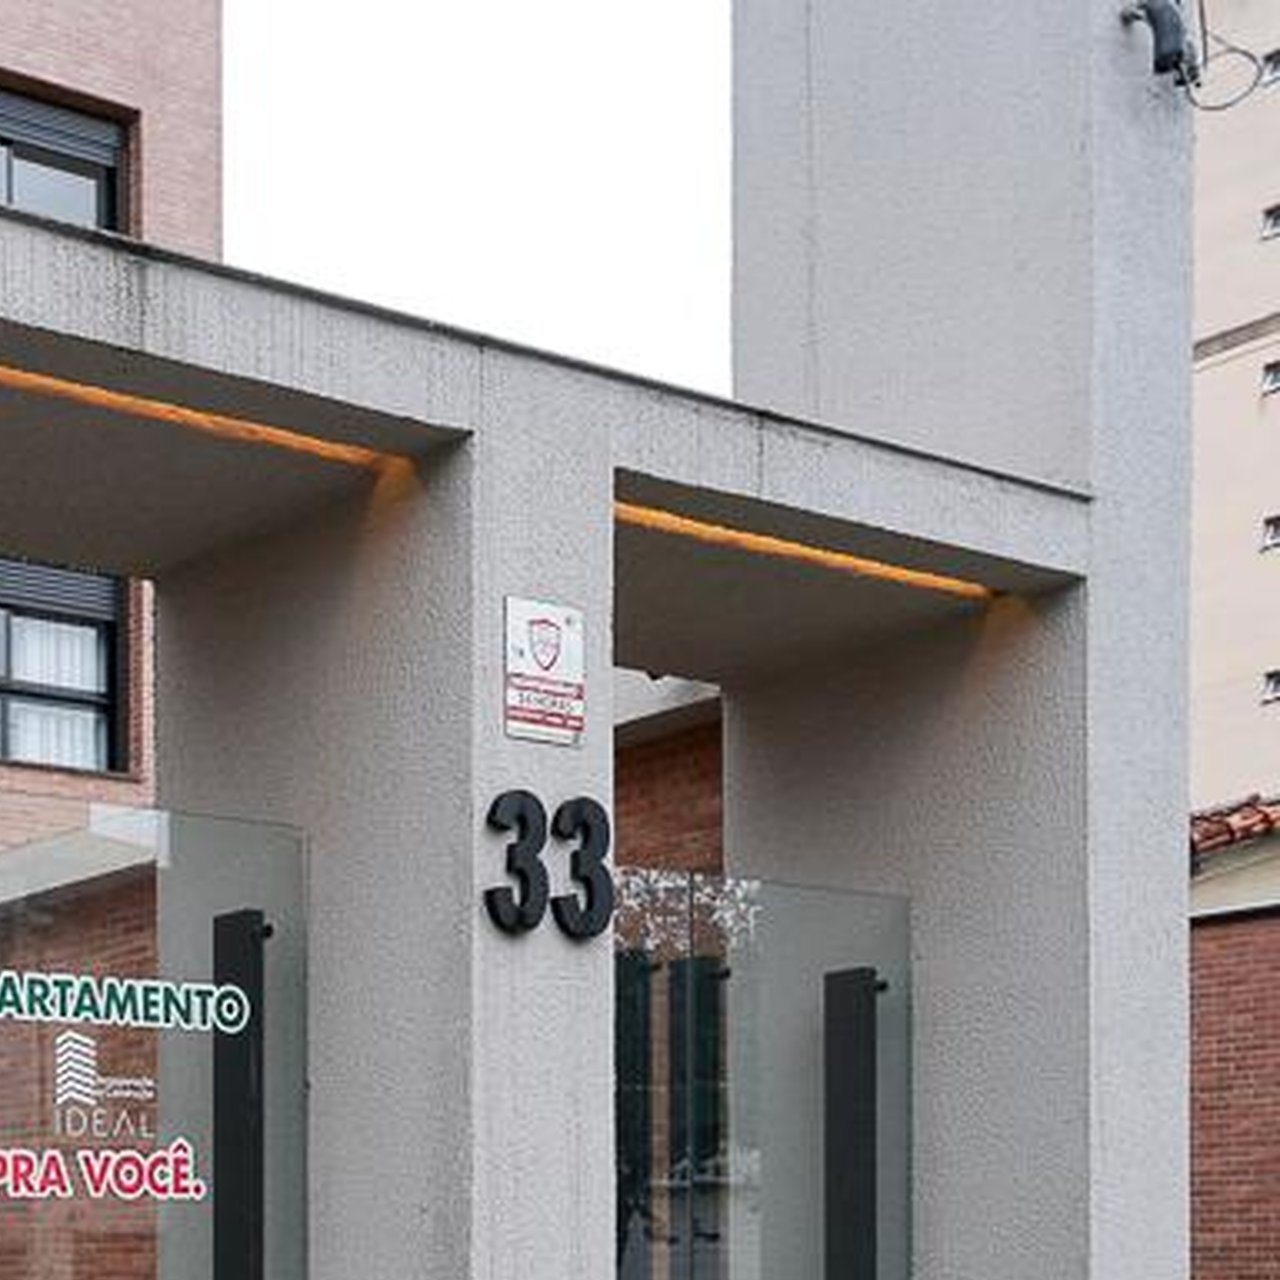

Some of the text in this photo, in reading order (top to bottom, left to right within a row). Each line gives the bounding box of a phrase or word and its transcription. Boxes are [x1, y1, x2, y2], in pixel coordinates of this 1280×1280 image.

[483, 789, 614, 940] 33
[54, 1106, 157, 1139] IDEAL
[79, 1137, 207, 1200] VOCÊ.
